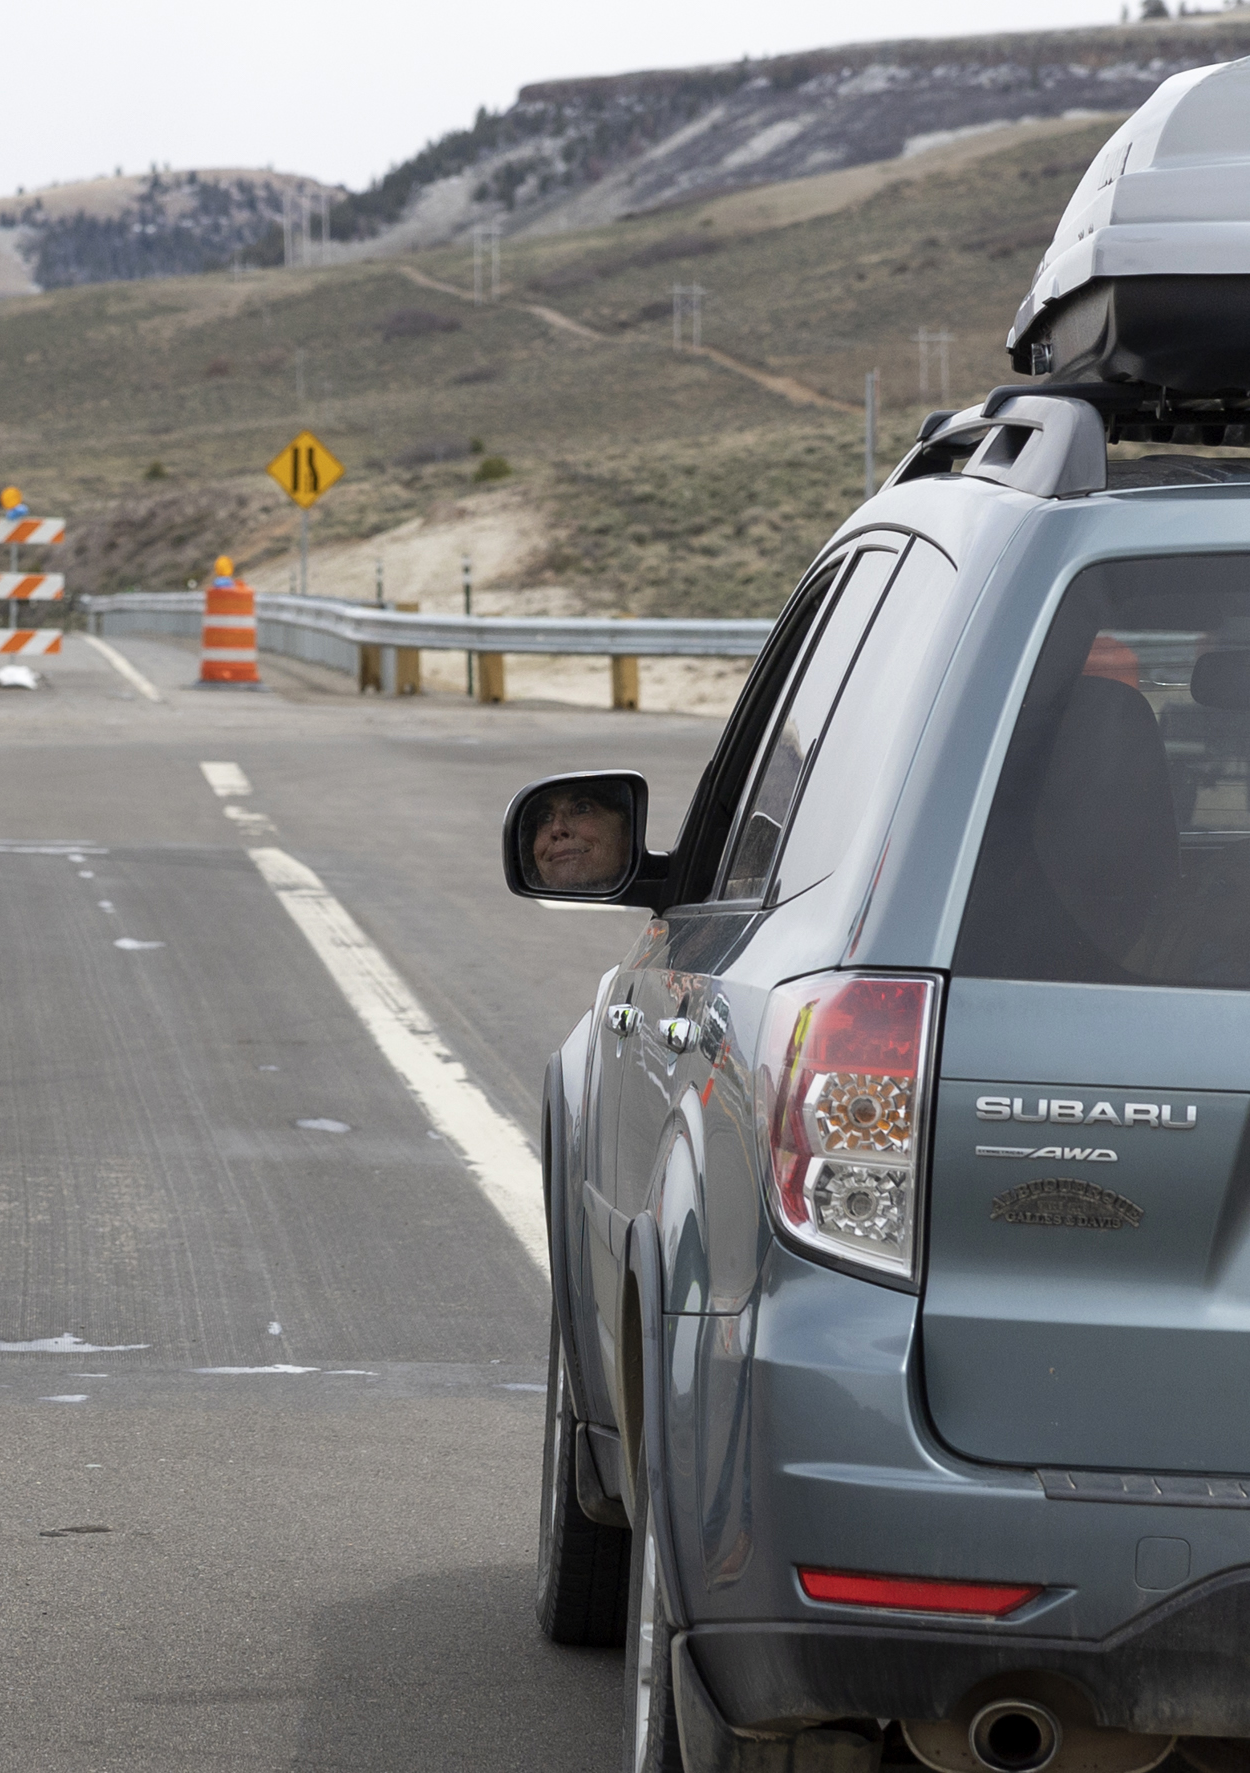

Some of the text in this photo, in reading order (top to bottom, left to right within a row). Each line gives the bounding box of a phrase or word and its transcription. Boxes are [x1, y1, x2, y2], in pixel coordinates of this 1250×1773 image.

[975, 1096, 1197, 1129] SUBARU
[1026, 1146, 1119, 1162] AWD
[991, 1177, 1145, 1223] ALBUQUERQUE
[1005, 1212, 1123, 1229] GALLES & DAVIS
